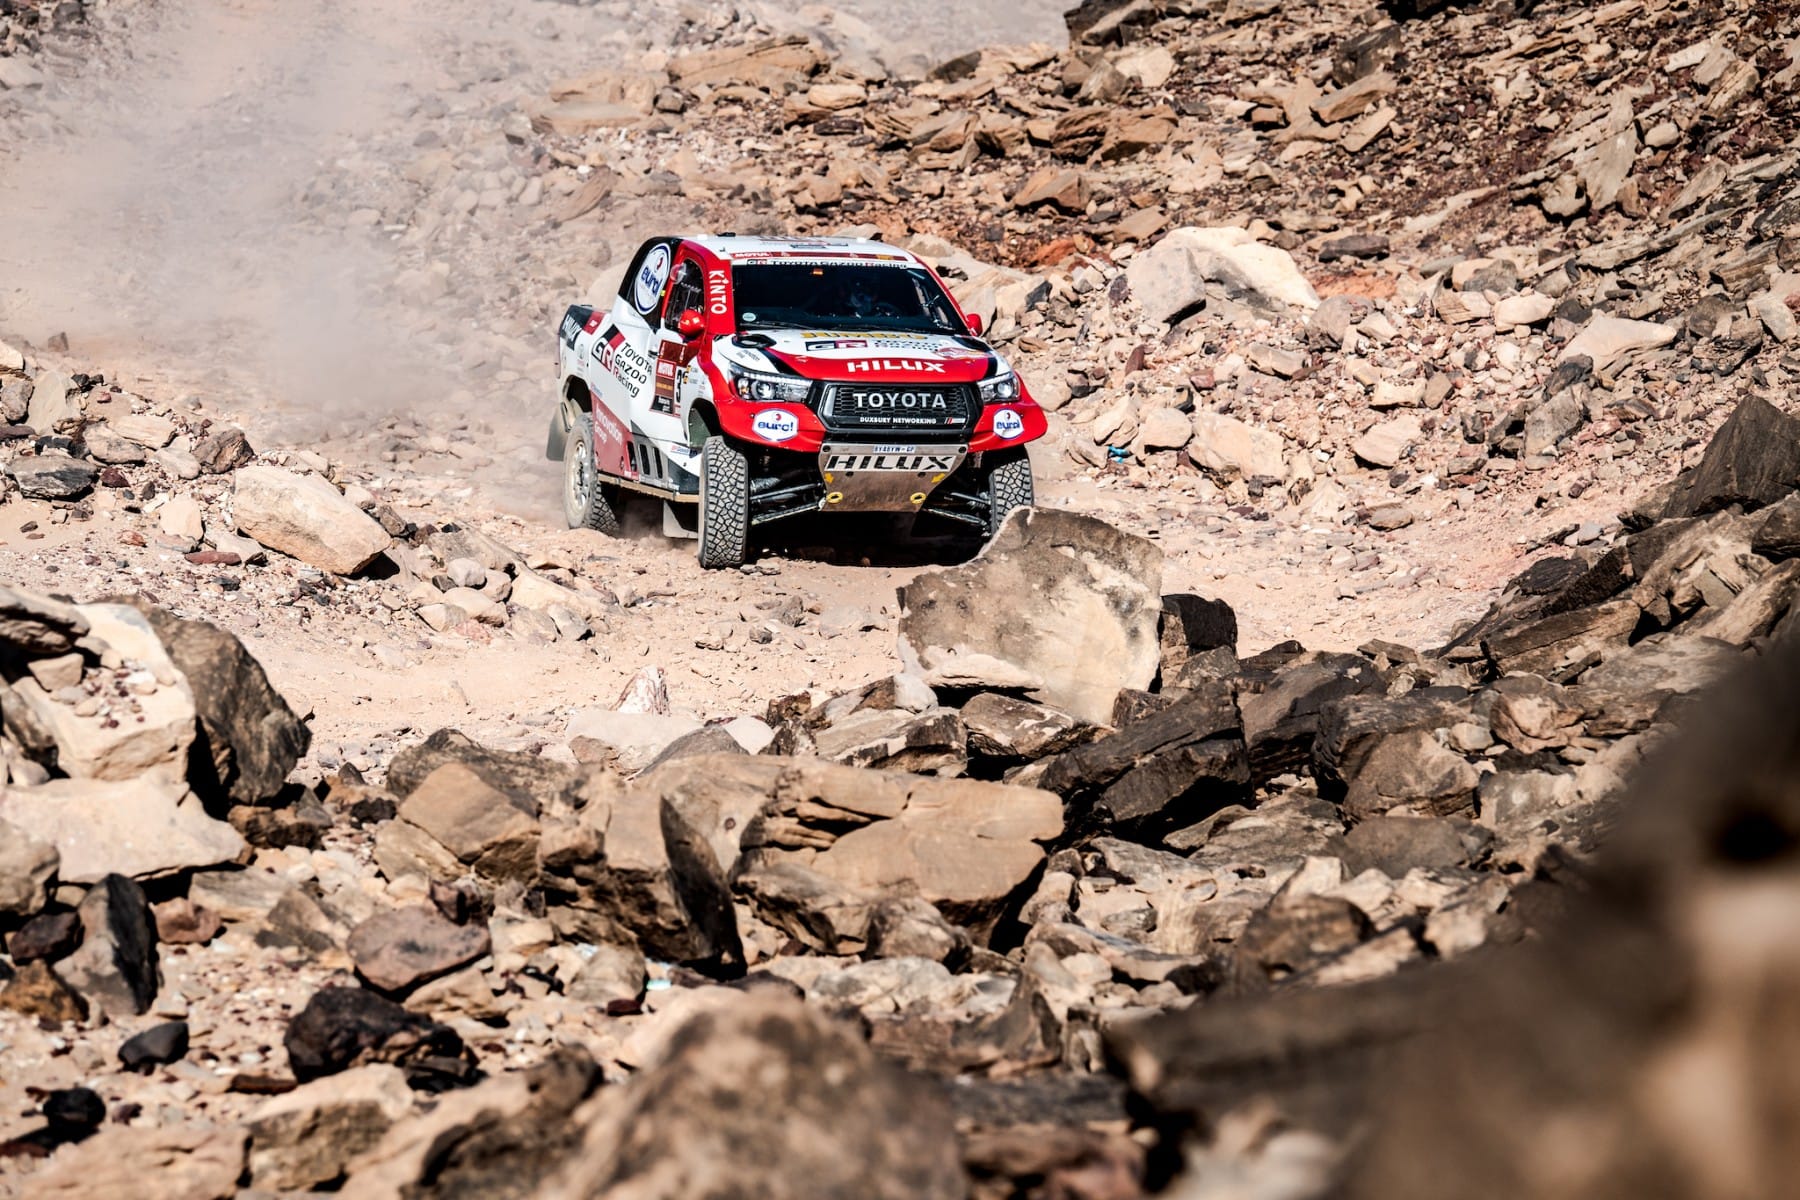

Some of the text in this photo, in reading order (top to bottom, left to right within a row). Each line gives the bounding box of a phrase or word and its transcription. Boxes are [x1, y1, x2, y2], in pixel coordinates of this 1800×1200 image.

[615, 354, 647, 384] GAZOO
[620, 342, 652, 376] TOYOTA
[847, 360, 945, 373] HILUX
[613, 366, 640, 398] Racing
[852, 392, 947, 409] TOYOTA
[826, 455, 953, 470] HILUX
